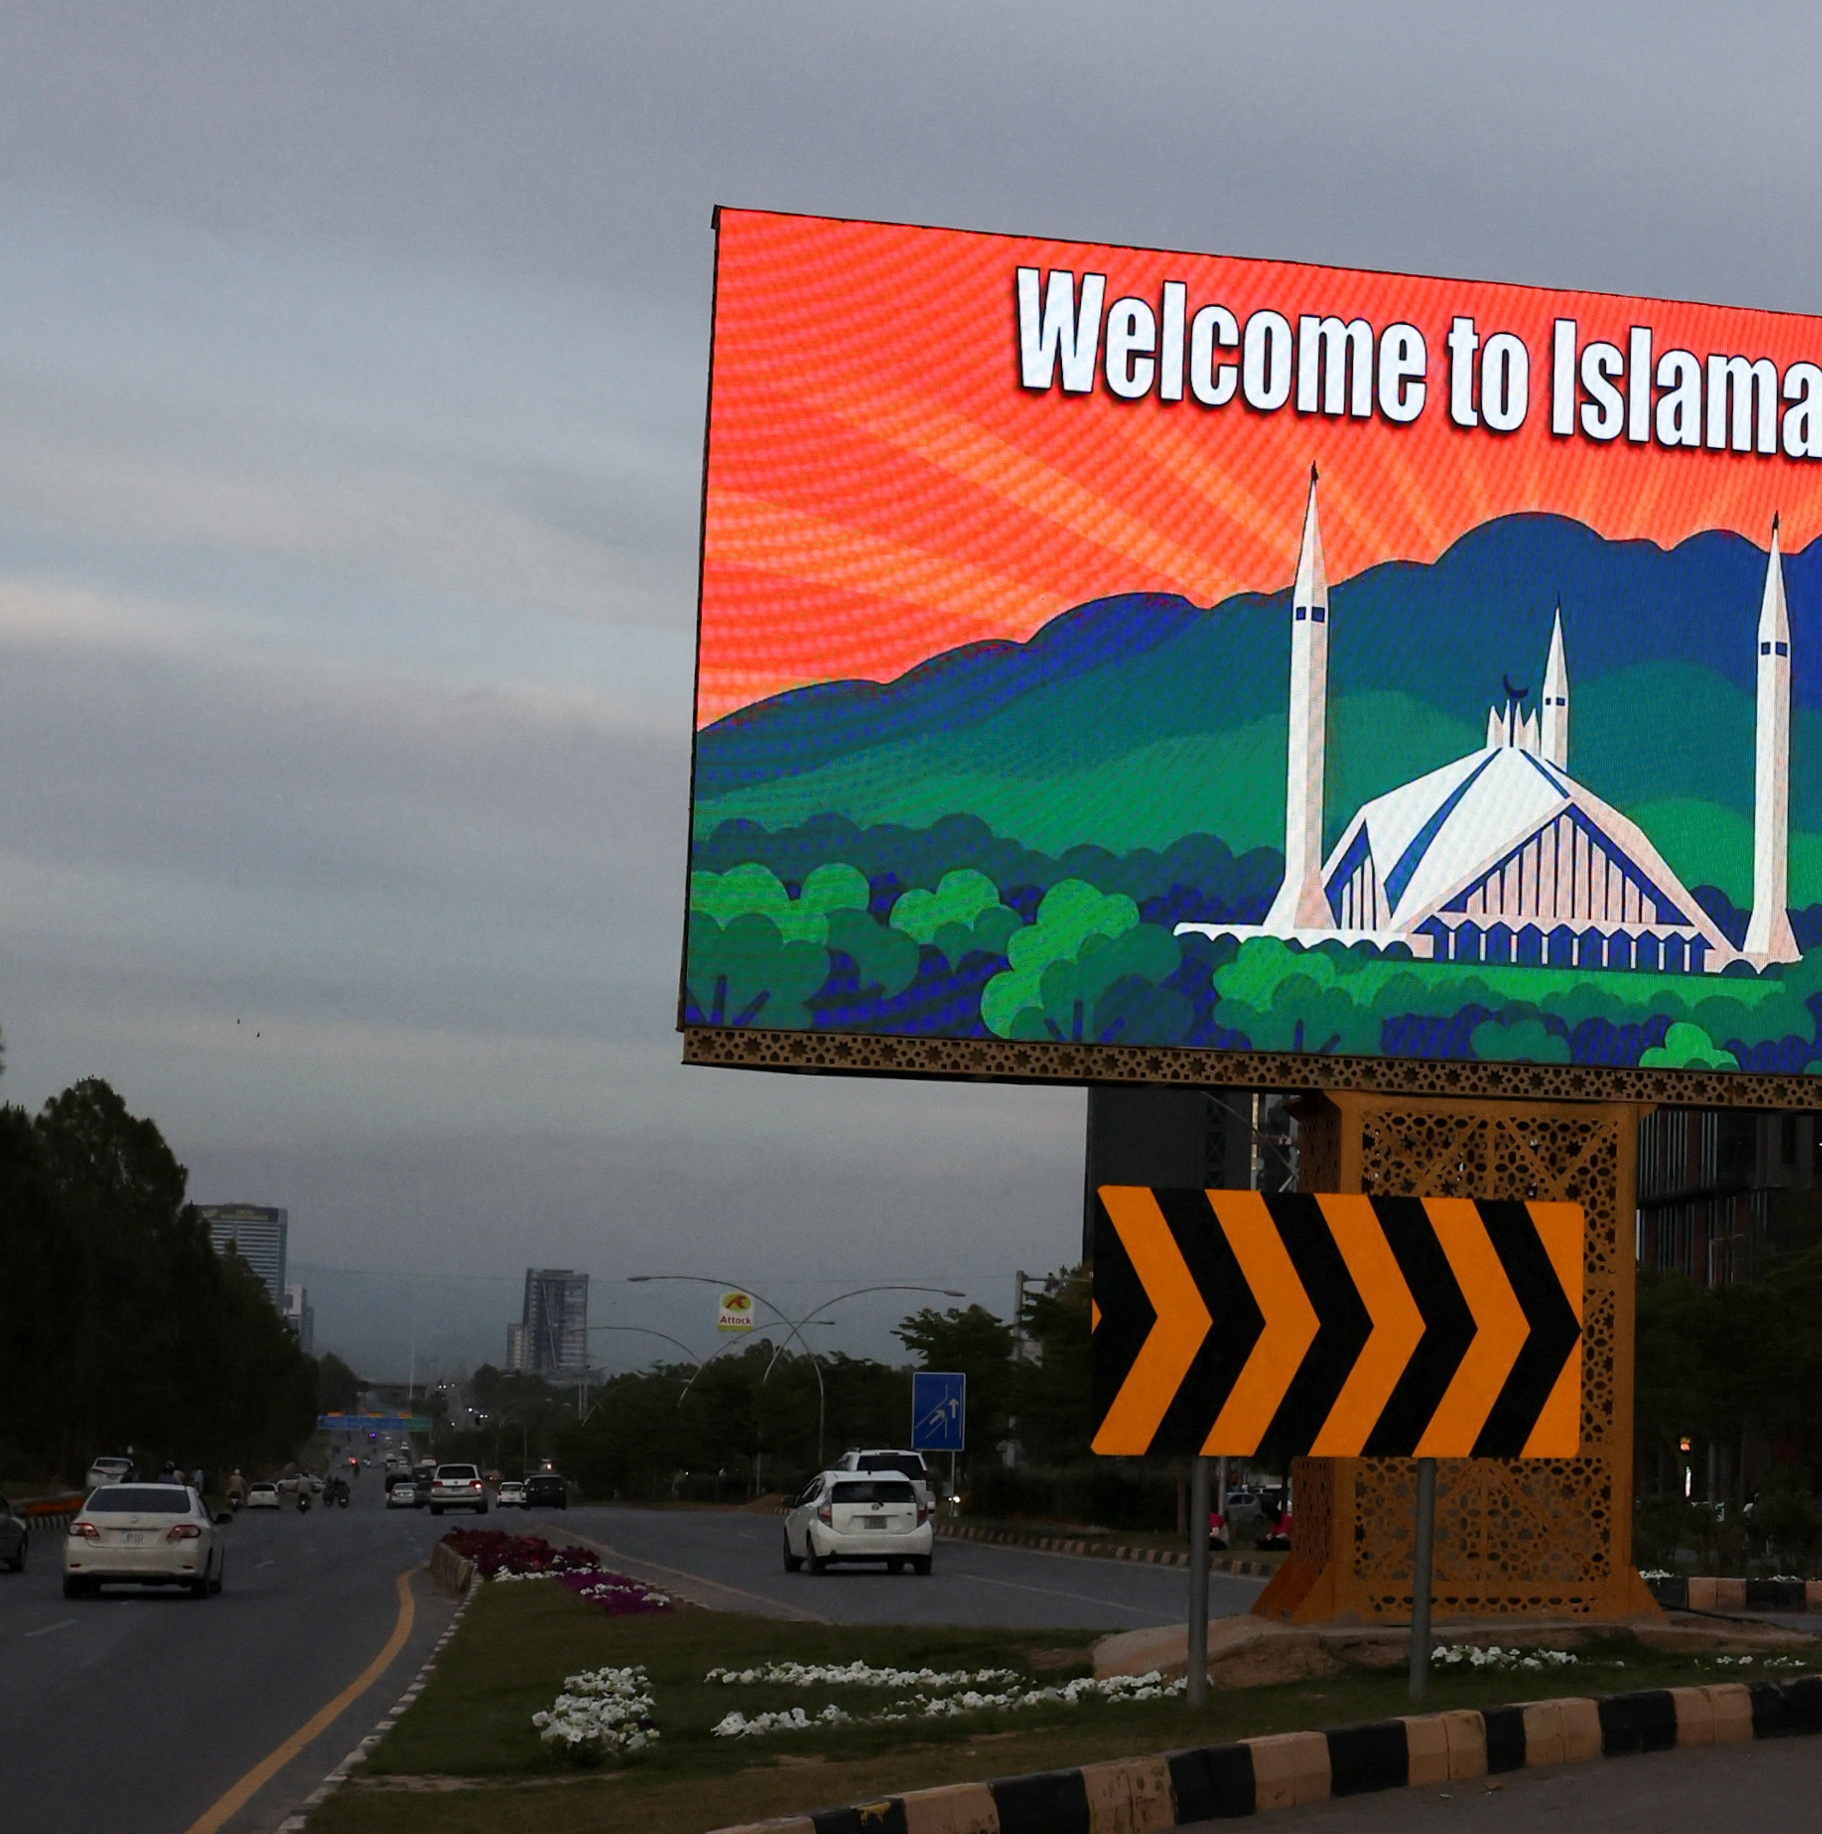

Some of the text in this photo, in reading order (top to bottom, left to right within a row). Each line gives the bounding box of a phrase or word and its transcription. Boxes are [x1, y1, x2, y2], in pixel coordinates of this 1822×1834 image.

[1014, 266, 1428, 422] Welcome
[1448, 316, 1530, 432] to
[720, 1315, 751, 1325] Attock
